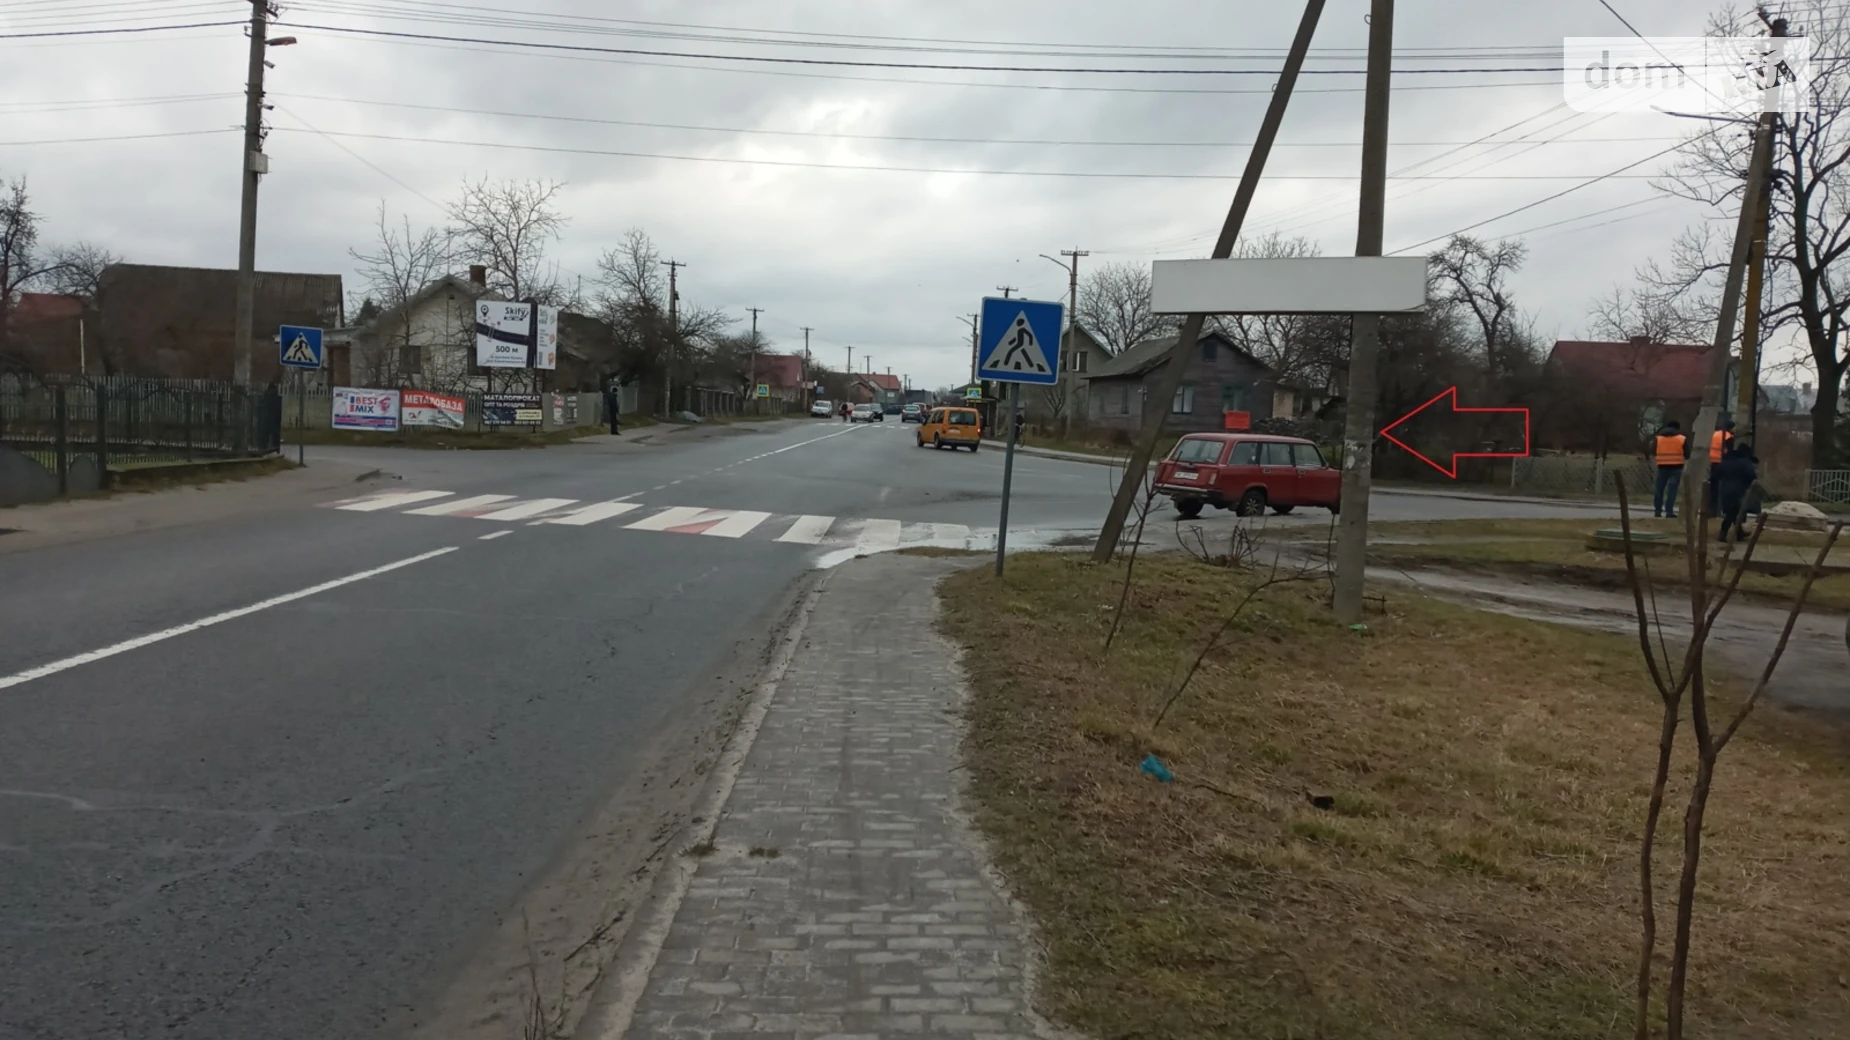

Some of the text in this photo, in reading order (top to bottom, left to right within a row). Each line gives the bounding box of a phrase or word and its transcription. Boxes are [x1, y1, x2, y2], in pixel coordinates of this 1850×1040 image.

[505, 307, 526, 317] Skify
[496, 345, 510, 353] 500
[355, 396, 378, 405] BEST
[404, 394, 463, 411] МЕТАЛОБАЗА
[355, 405, 374, 413] MIX
